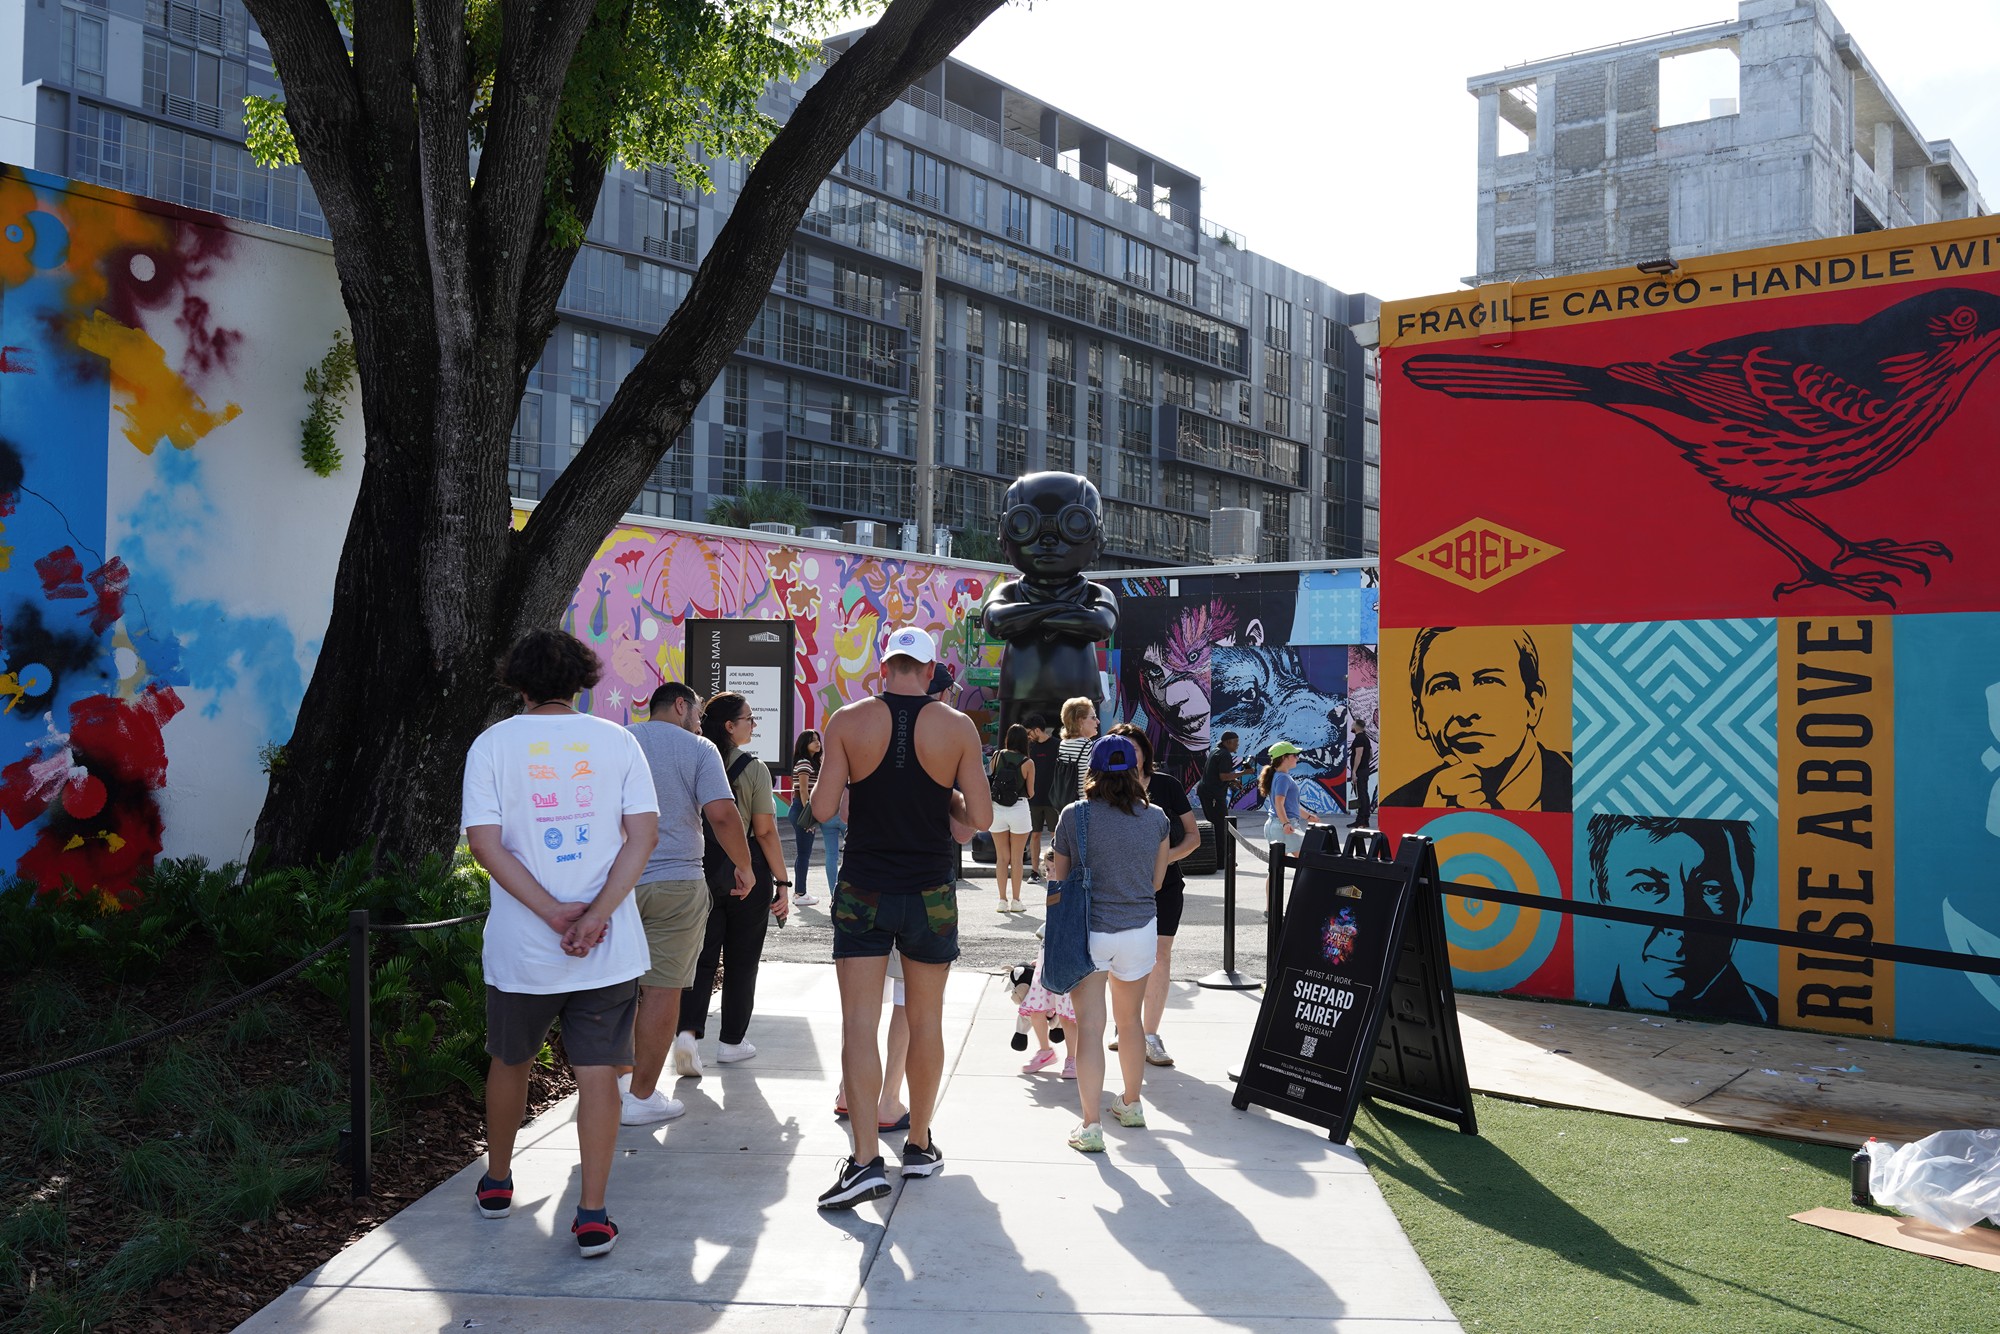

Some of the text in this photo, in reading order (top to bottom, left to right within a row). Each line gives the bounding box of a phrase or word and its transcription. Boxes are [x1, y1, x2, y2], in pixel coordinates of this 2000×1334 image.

[1398, 295, 1550, 338] FRAGILE
[1562, 278, 1701, 317] CARGO
[1732, 249, 1915, 298] HANDLE
[1930, 237, 2000, 271] WI
[1428, 528, 1530, 581] OBEY
[711, 630, 721, 697] WALLS MAIN
[895, 709, 908, 769] CORENGTH
[1796, 619, 1874, 1025] RISE ABOVE
[1293, 979, 1355, 1010] SHEPARD
[1304, 969, 1353, 986] ARTIST AT WORK
[1294, 1000, 1343, 1028] FAIREY
[1294, 1021, 1333, 1038] @OBEYGIANT
